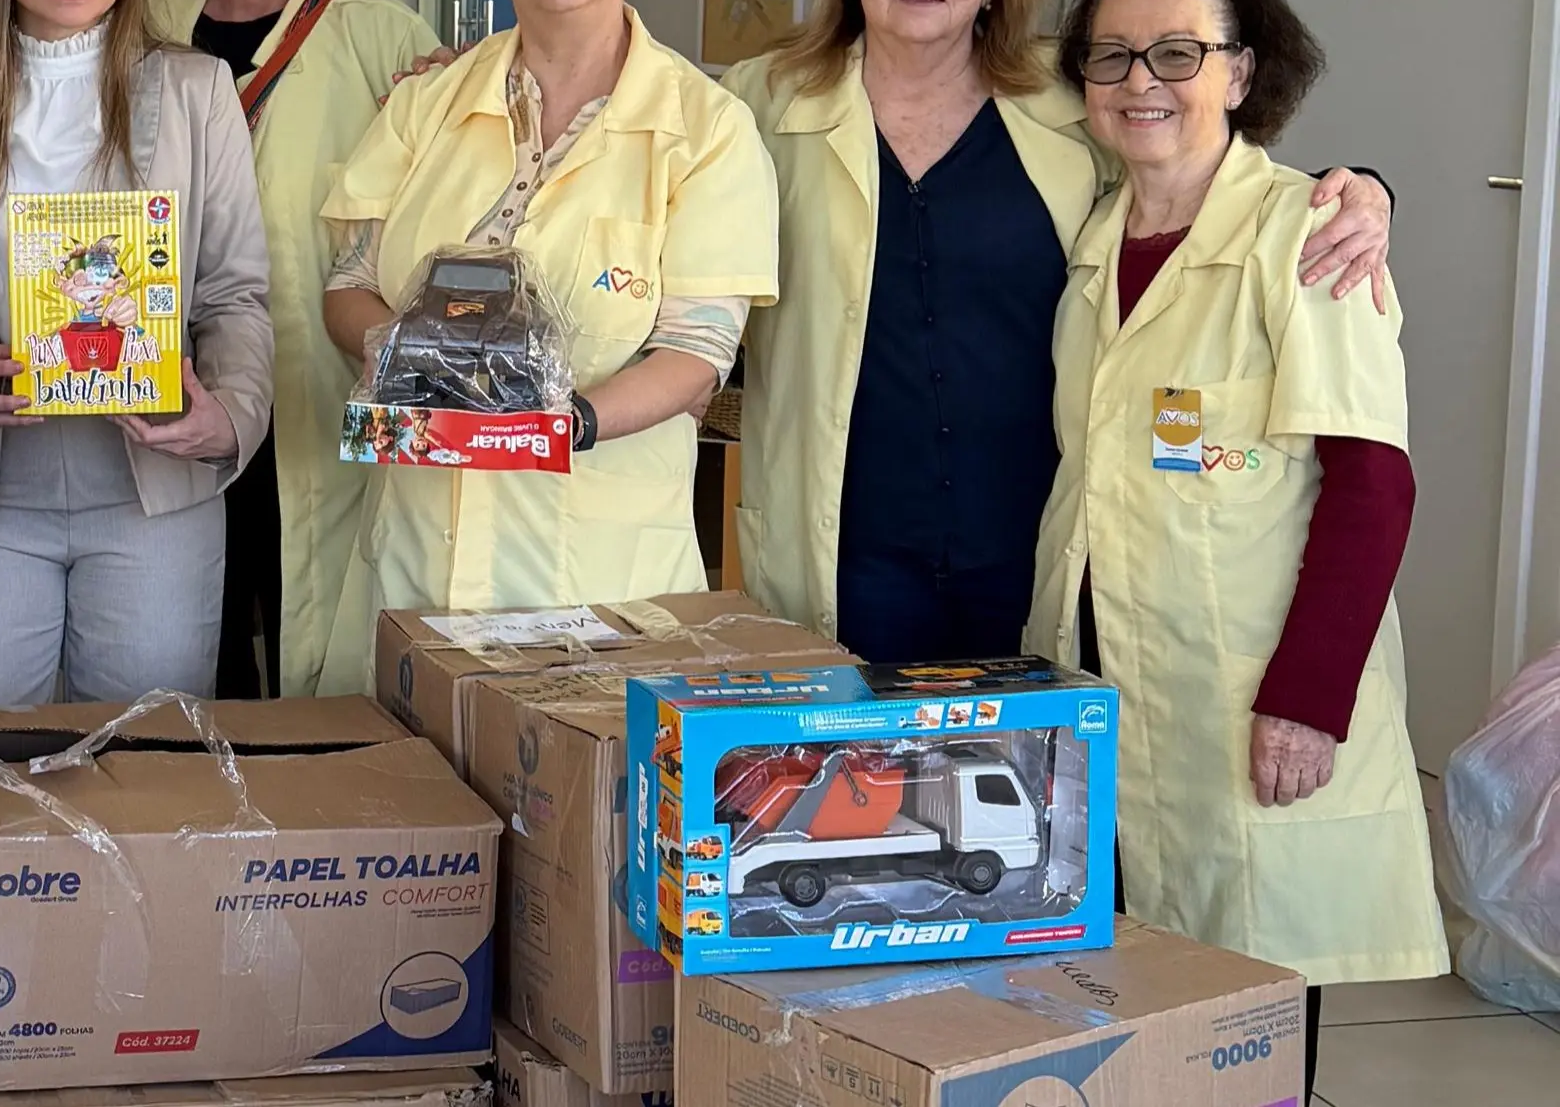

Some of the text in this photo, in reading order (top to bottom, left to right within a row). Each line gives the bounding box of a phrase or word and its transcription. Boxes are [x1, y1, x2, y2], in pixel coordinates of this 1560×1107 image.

[1156, 407, 1200, 427] AVOS
[466, 434, 550, 458] Baluar
[244, 851, 481, 884] PAPEL TOALHA
[215, 883, 490, 913] INTERFOLHAS COMFORT
[830, 922, 971, 950] Urban
[9, 1022, 58, 1037] 4800
[60, 1027, 95, 1035] FOLHAS
[696, 1003, 761, 1043] GOEDERT
[122, 1034, 190, 1048] Cód. 37224
[1211, 1035, 1272, 1071] 9000
